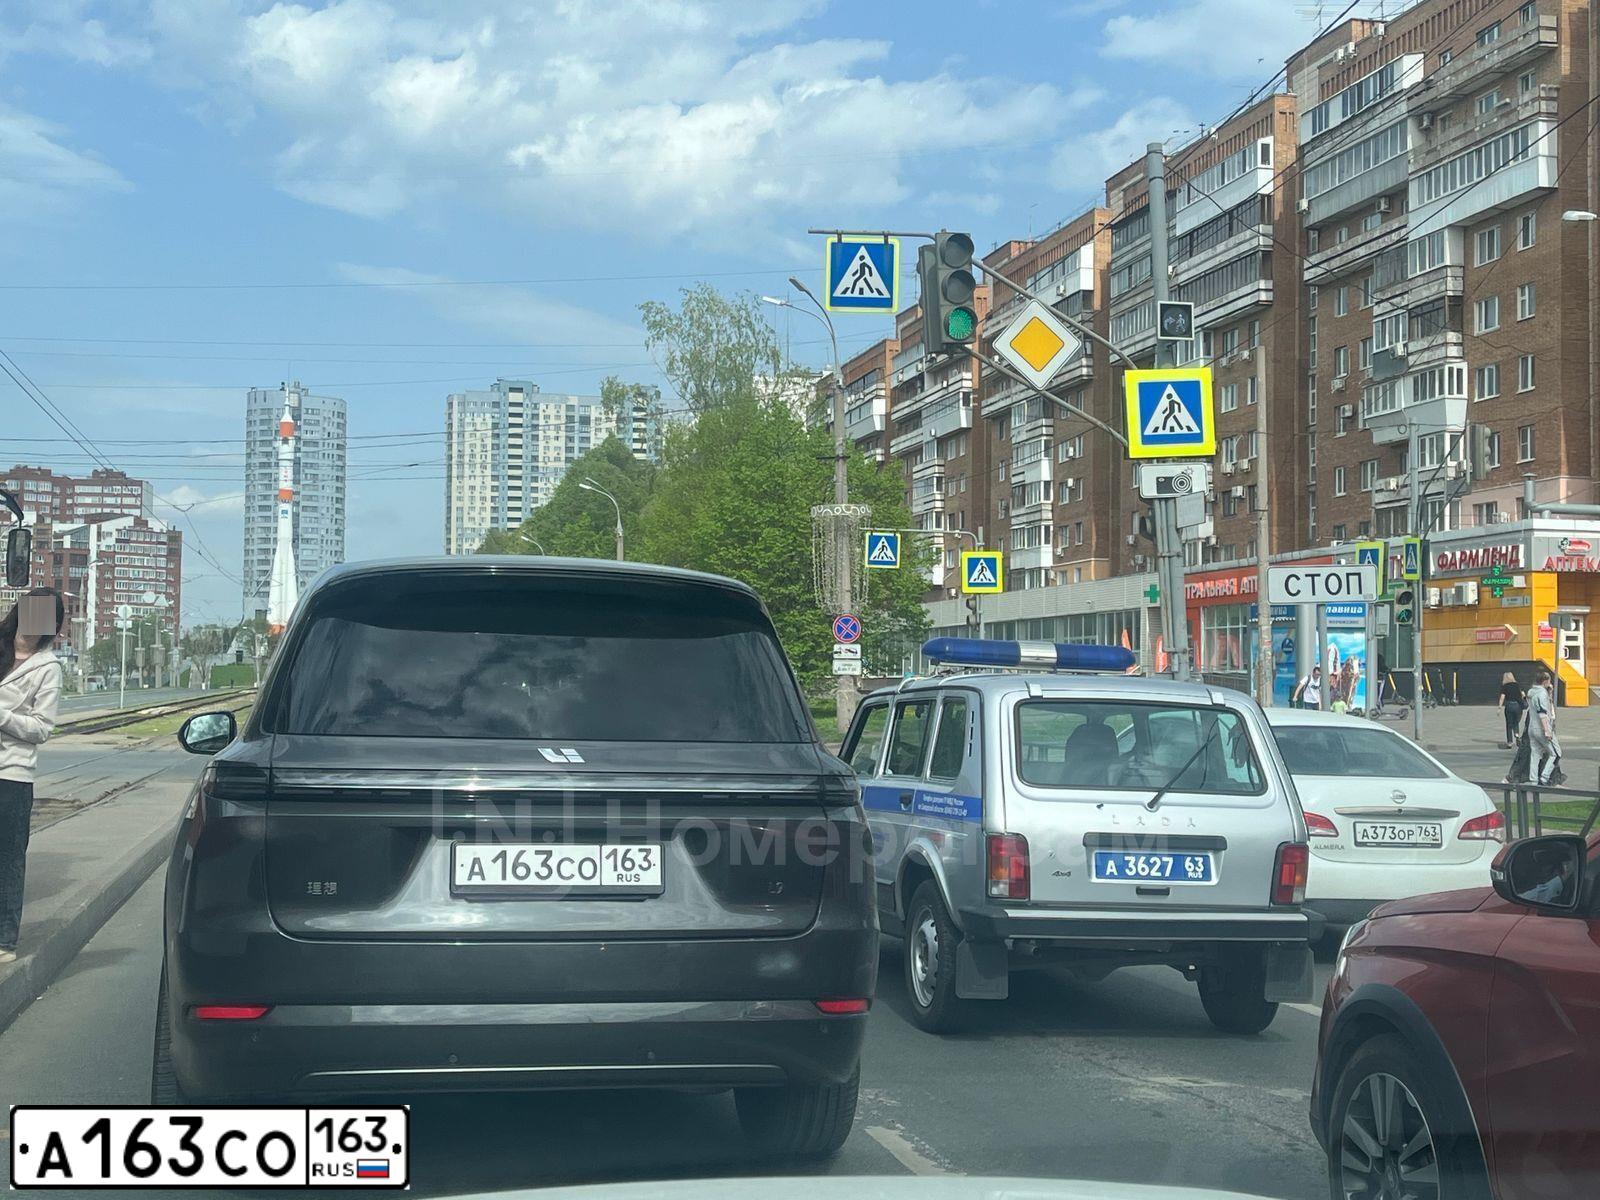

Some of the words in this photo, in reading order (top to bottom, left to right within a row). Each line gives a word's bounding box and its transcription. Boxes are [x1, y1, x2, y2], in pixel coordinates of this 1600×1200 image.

[1437, 543, 1524, 570] ФАРМЛЕНД
[1284, 572, 1363, 597] СТОП
[1361, 825, 1415, 840] А373ОР
[1417, 826, 1437, 837] 763
[467, 850, 598, 881] А163СО
[605, 848, 652, 872] 163
[1105, 860, 1118, 876] А
[1124, 856, 1174, 877] 3627
[1184, 857, 1205, 872] 63
[616, 873, 641, 883] RUS
